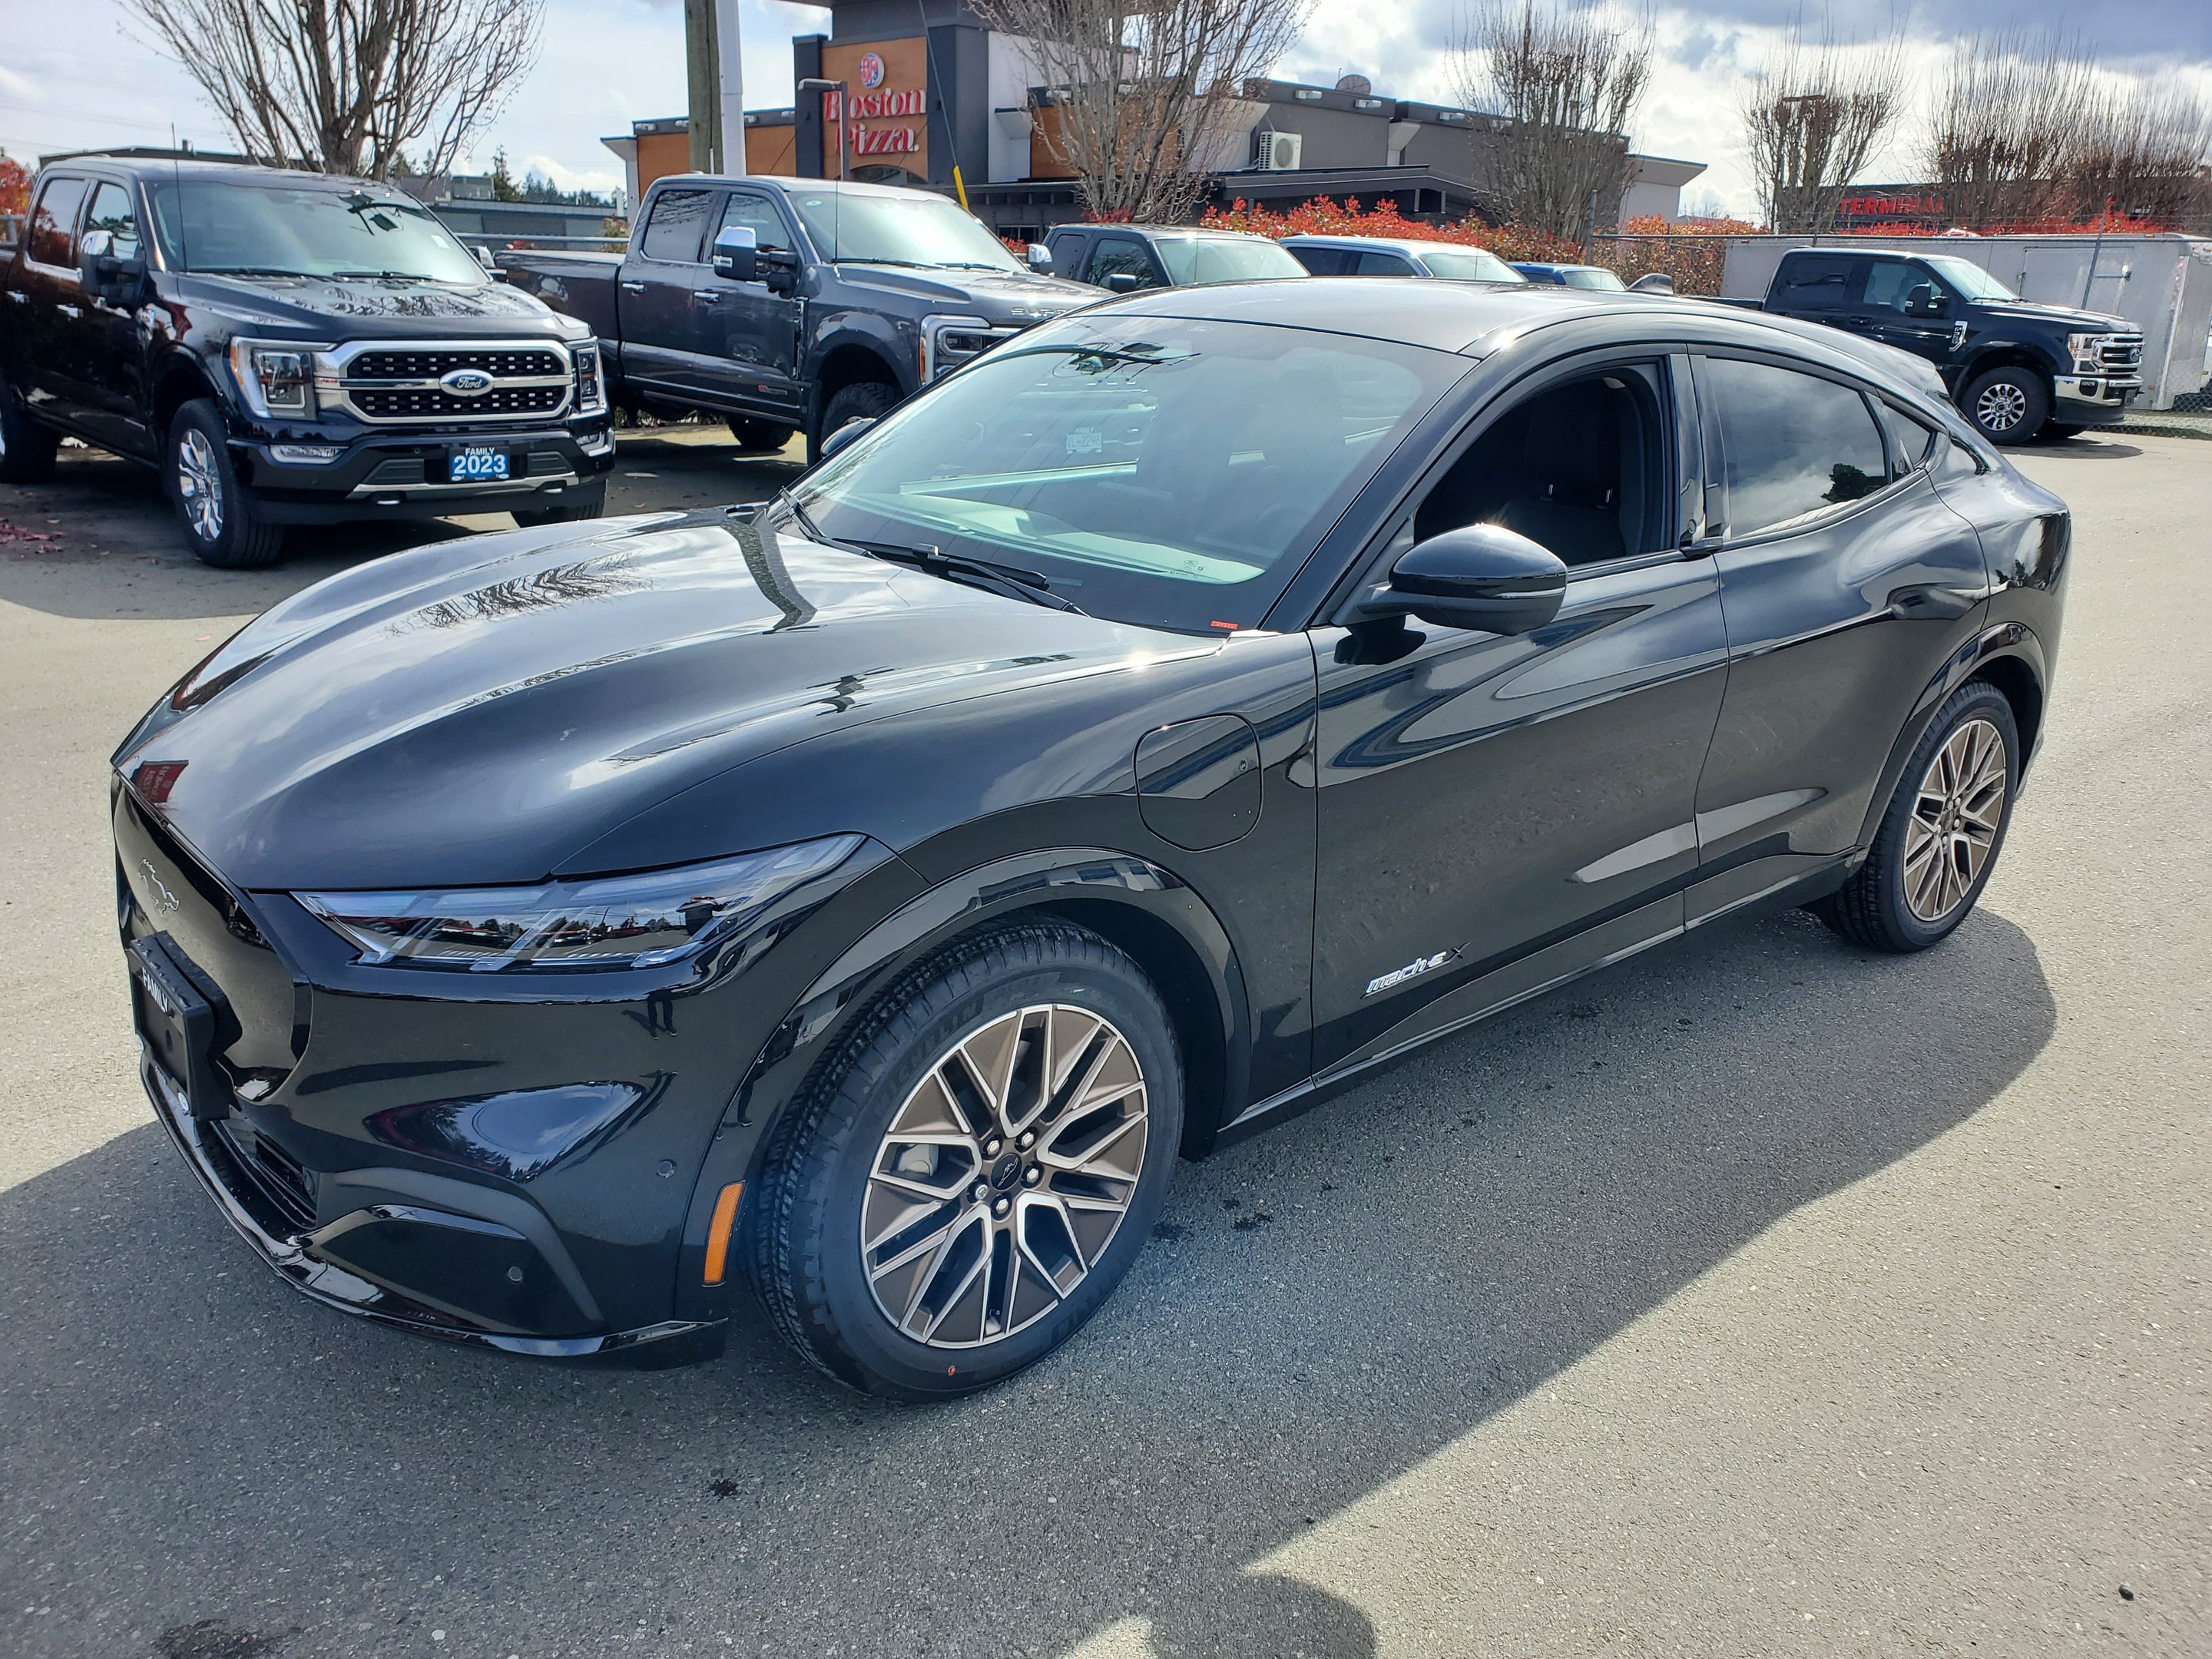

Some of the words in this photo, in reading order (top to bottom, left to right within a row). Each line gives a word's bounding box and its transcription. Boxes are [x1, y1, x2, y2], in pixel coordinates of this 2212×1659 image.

[825, 88, 926, 121] Boston
[456, 376, 482, 389] Ford
[465, 447, 495, 455] FAMILY
[454, 455, 506, 474] 2023
[141, 966, 169, 1013] FAMILY
